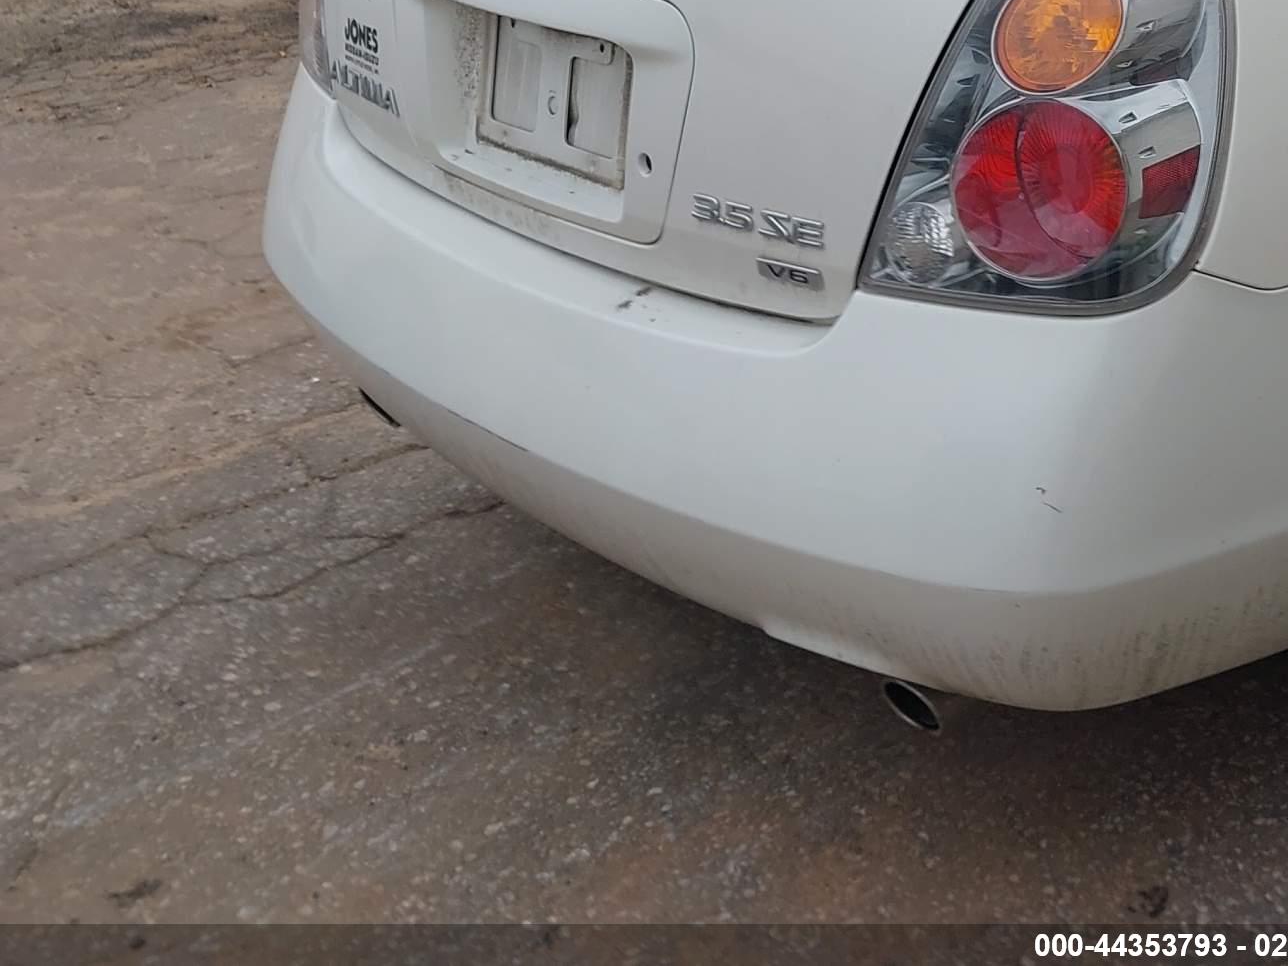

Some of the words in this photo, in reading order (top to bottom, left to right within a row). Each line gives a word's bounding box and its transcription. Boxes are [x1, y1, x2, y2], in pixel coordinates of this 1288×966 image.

[344, 17, 379, 54] JONES
[757, 208, 825, 250] SE
[767, 264, 809, 285] V6
